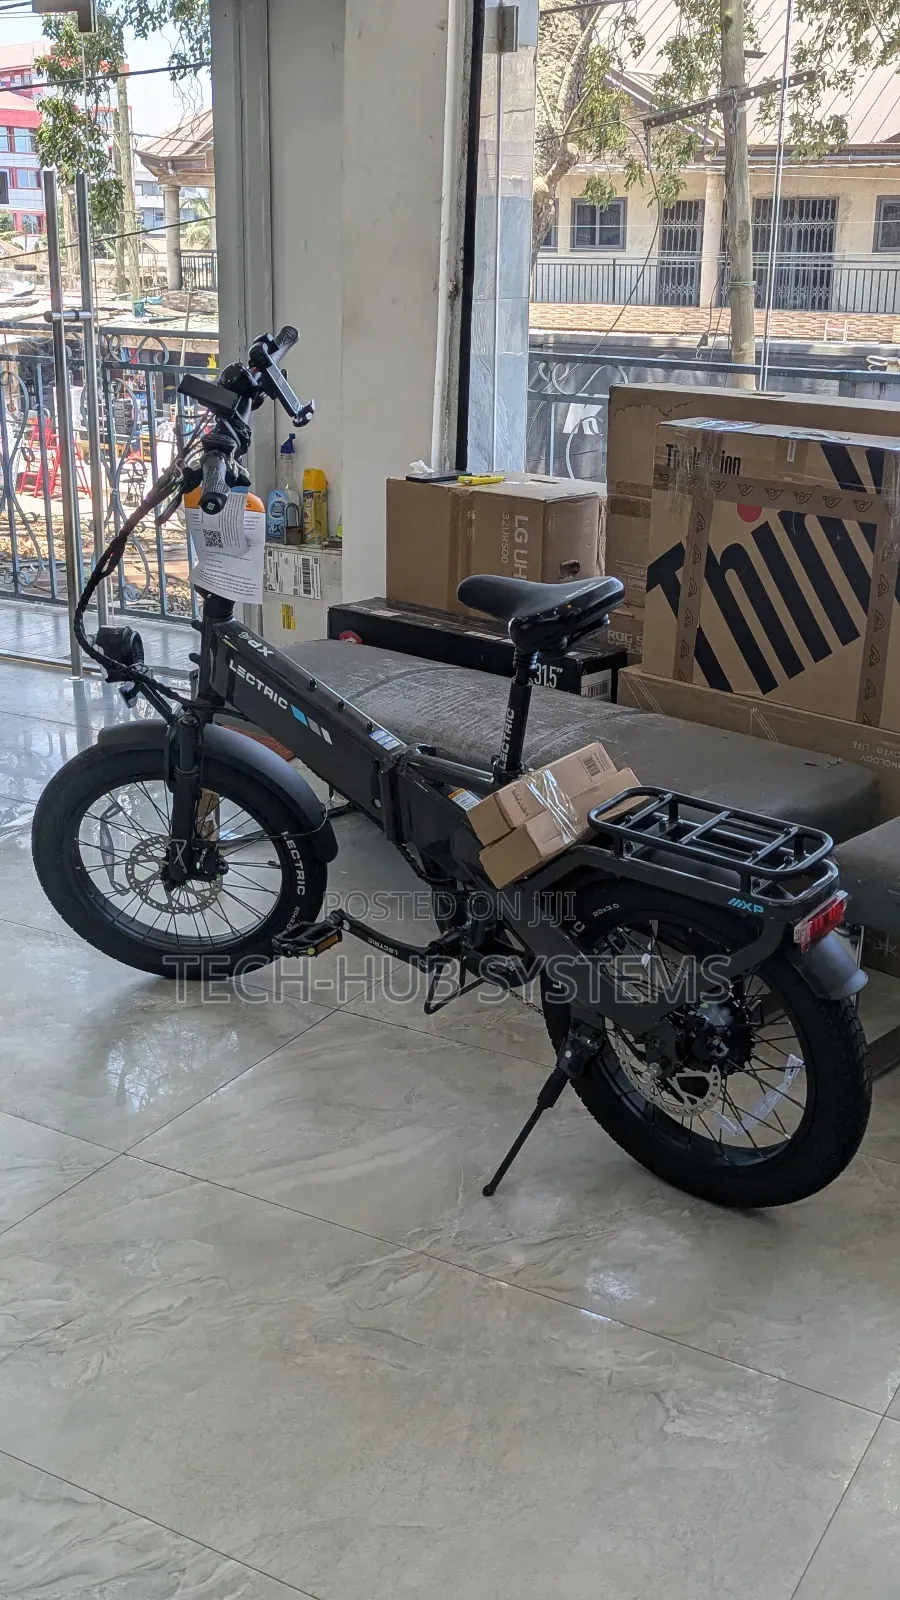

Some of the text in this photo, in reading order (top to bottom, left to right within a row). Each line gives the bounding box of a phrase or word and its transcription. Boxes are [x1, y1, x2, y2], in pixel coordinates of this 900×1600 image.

[514, 514, 529, 544] LG
[607, 629, 633, 644] ROG
[229, 658, 289, 710] LECTRIC
[499, 707, 515, 770] LECTRIC
[281, 831, 305, 896] LECTRIC
